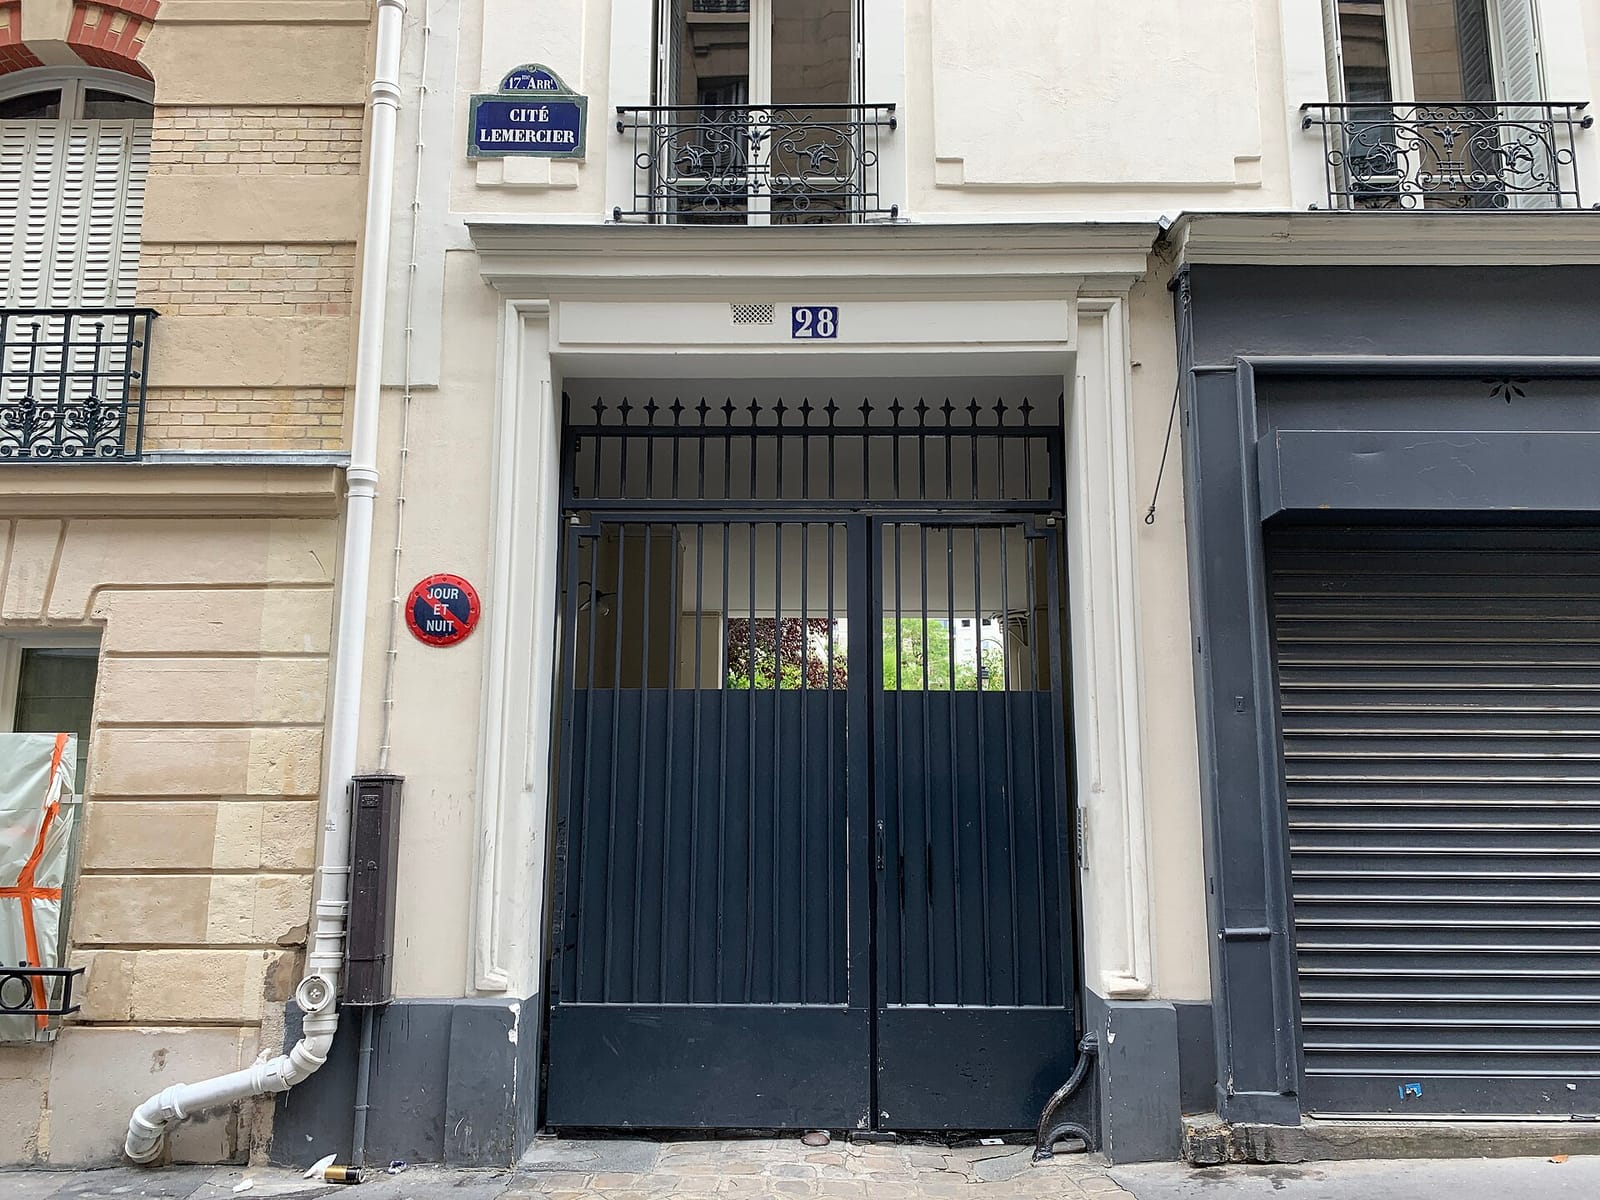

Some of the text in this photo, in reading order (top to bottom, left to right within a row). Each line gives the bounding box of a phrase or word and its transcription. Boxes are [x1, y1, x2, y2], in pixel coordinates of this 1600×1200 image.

[509, 106, 549, 122] CITÉ
[480, 128, 575, 143] LEMERCIER
[795, 308, 834, 337] 28
[427, 588, 459, 600] JOUR
[433, 604, 449, 615] ET
[426, 620, 454, 632] NUIT
